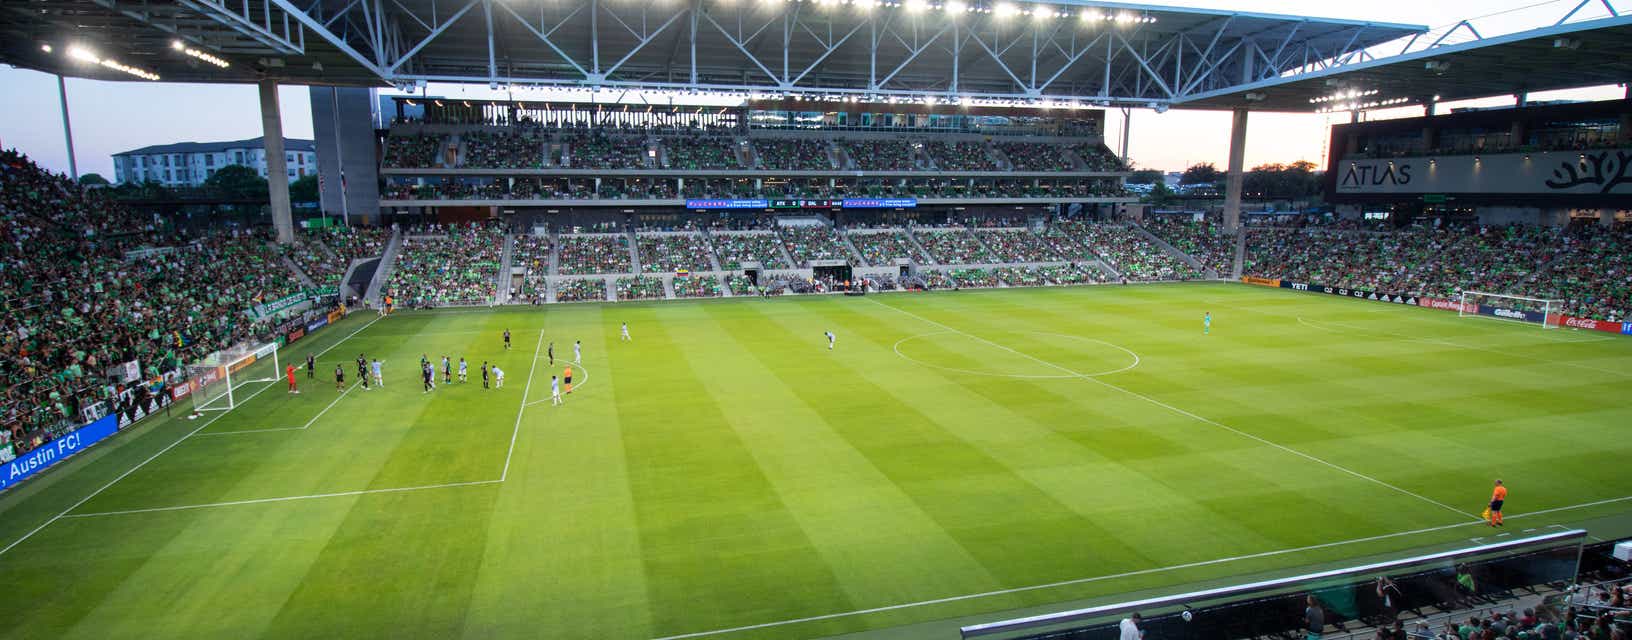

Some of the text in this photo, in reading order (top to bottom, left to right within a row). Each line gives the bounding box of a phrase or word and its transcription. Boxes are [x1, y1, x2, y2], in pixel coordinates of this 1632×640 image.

[1342, 164, 1411, 186] ATLAS
[1291, 282, 1309, 291] YETI
[10, 448, 55, 480] Austin
[58, 432, 81, 455] FC!
